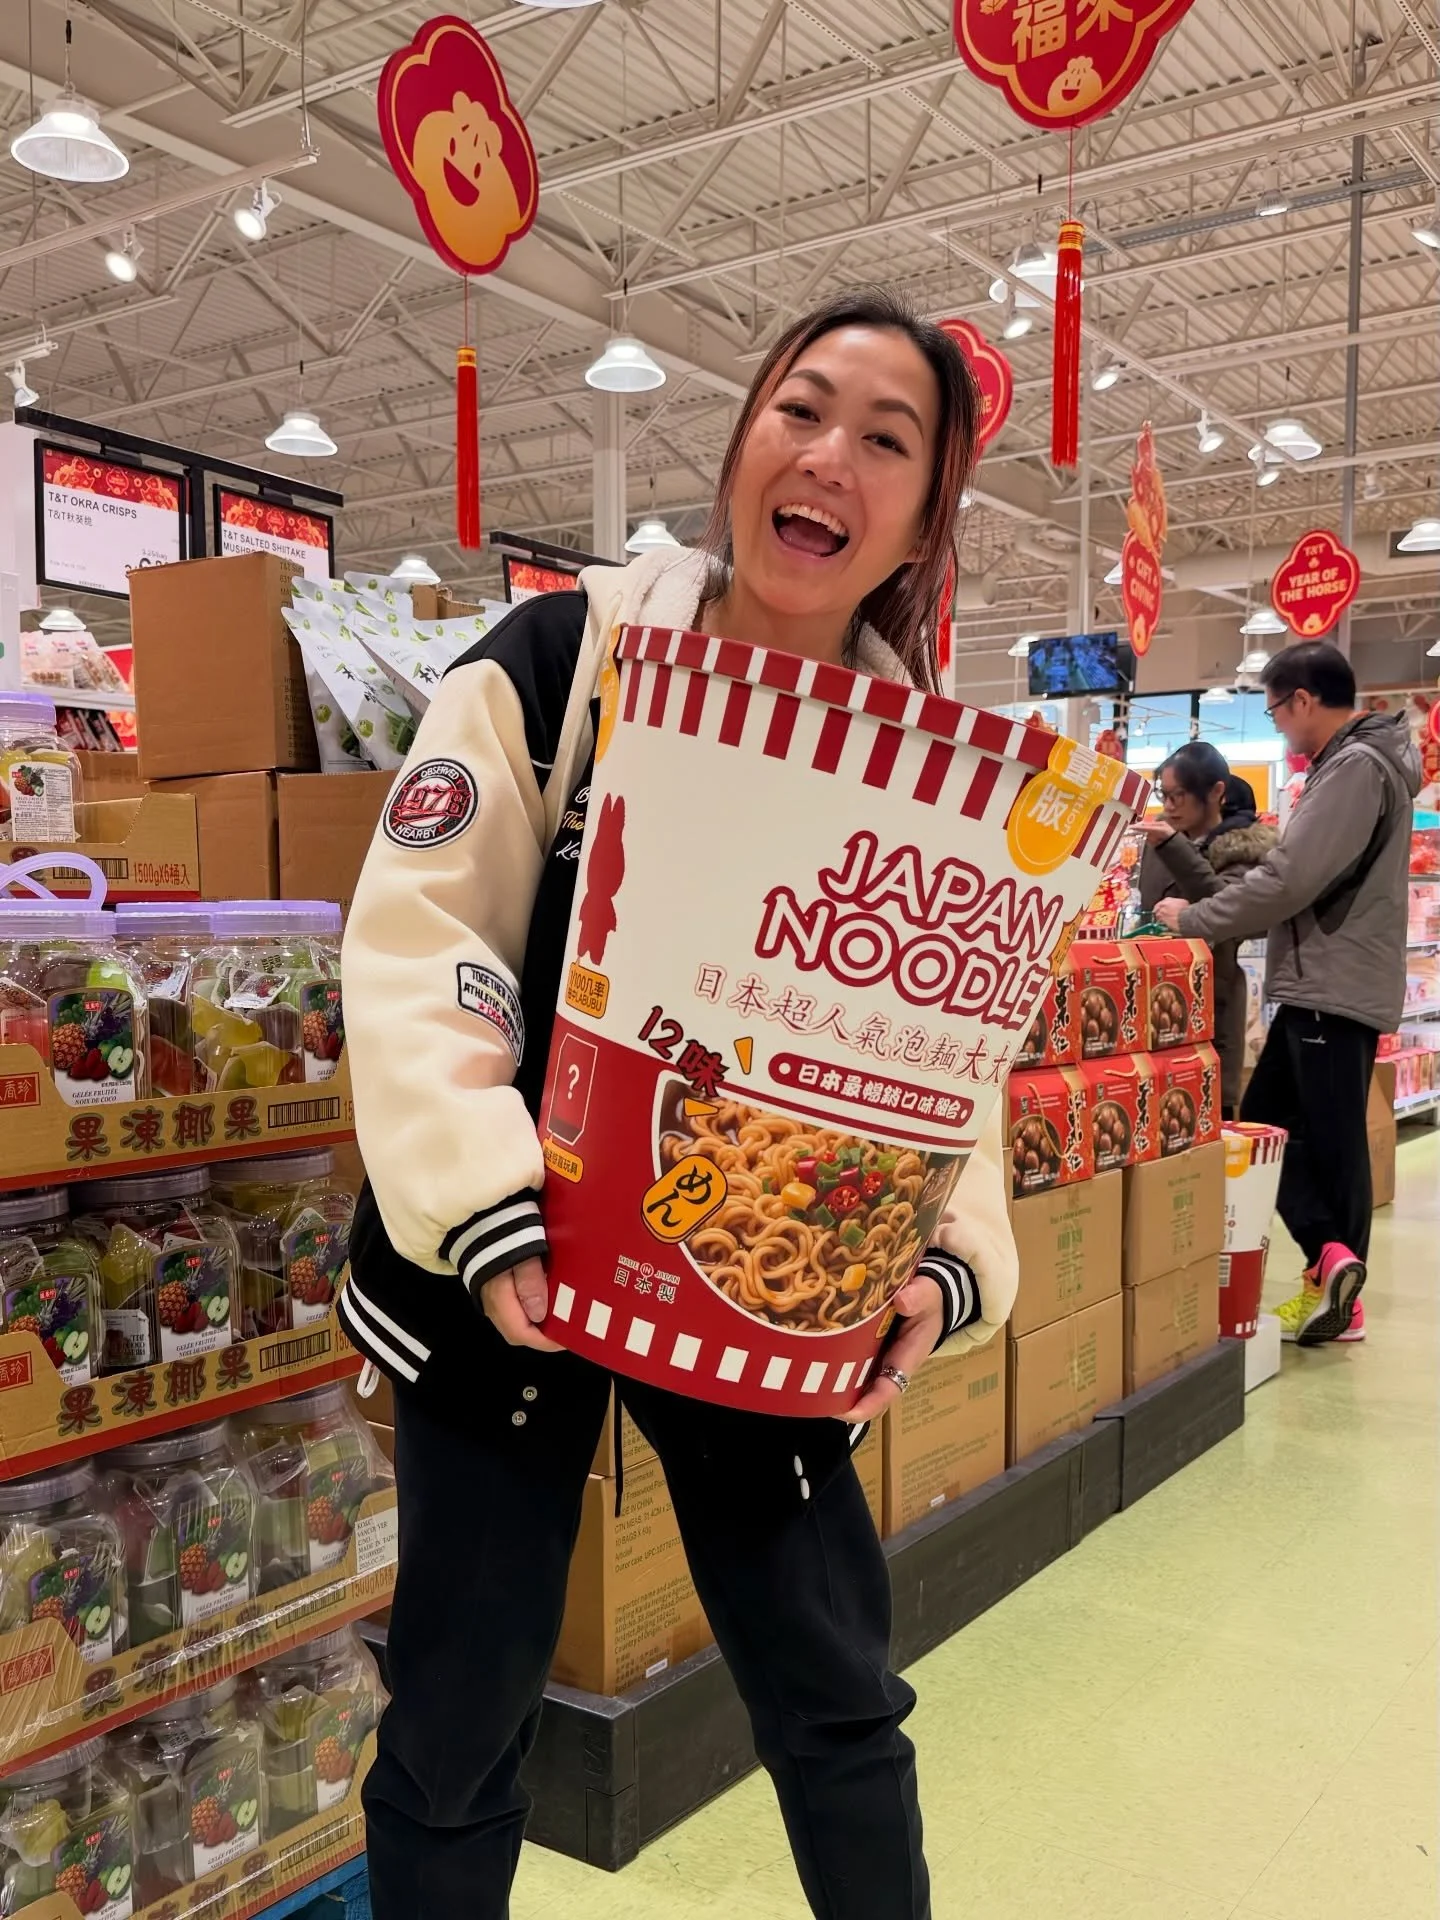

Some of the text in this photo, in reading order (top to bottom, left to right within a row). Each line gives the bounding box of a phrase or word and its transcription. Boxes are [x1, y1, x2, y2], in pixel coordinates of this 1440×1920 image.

[48, 491, 137, 519] T&T OKRA CRISPS
[223, 529, 307, 560] T&T SALTED SHIITAKE
[1136, 557, 1152, 585] GIFT
[1289, 567, 1339, 588] YEAR OF
[1130, 577, 1156, 611] GIVING
[1280, 579, 1348, 604] THE HORSE
[420, 765, 460, 781] OBSERVED
[395, 823, 437, 840] NEARBY
[818, 830, 1063, 958] JAPAN
[755, 885, 1051, 1030] NOODLE
[463, 981, 502, 1012] ATHLETIC
[471, 969, 506, 999] TOGETHER
[638, 1005, 730, 1097] 12味
[0, 1079, 33, 1102] 香珍
[614, 1267, 676, 1304] 日本製
[655, 1271, 680, 1284] JAPAN
